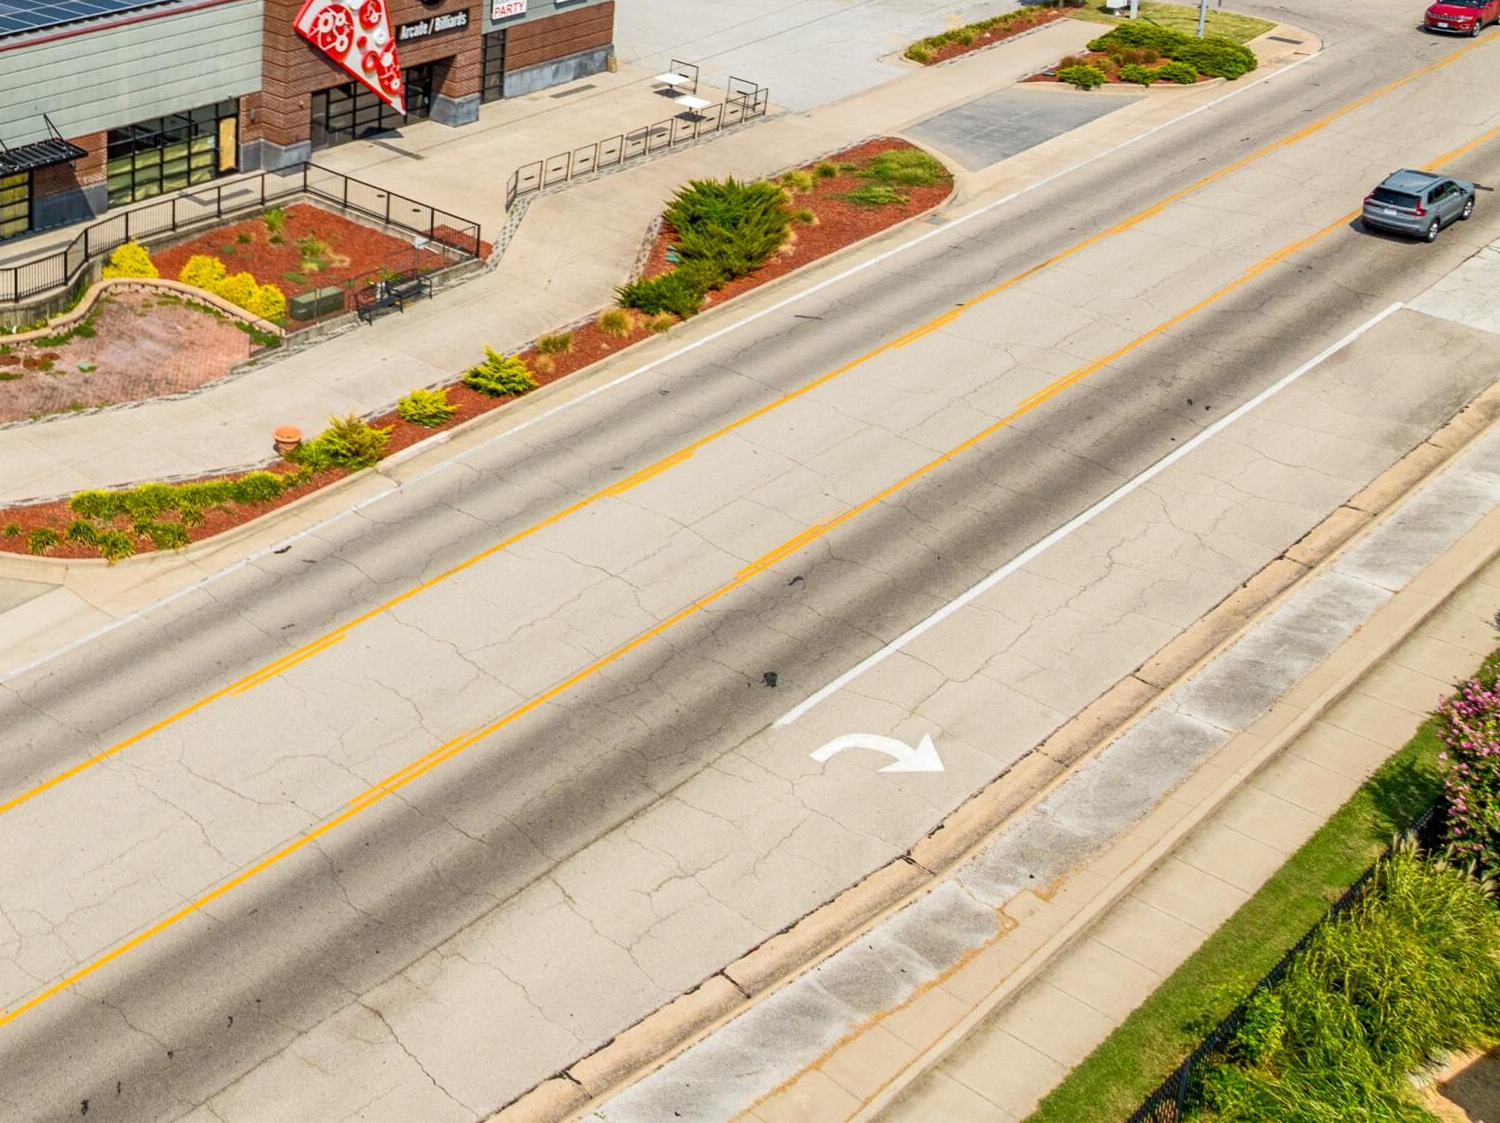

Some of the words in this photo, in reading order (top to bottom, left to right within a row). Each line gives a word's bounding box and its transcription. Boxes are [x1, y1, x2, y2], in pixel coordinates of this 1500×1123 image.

[494, 1, 525, 17] PARTY
[401, 21, 428, 40] Arcade
[435, 12, 467, 31] Billiards
